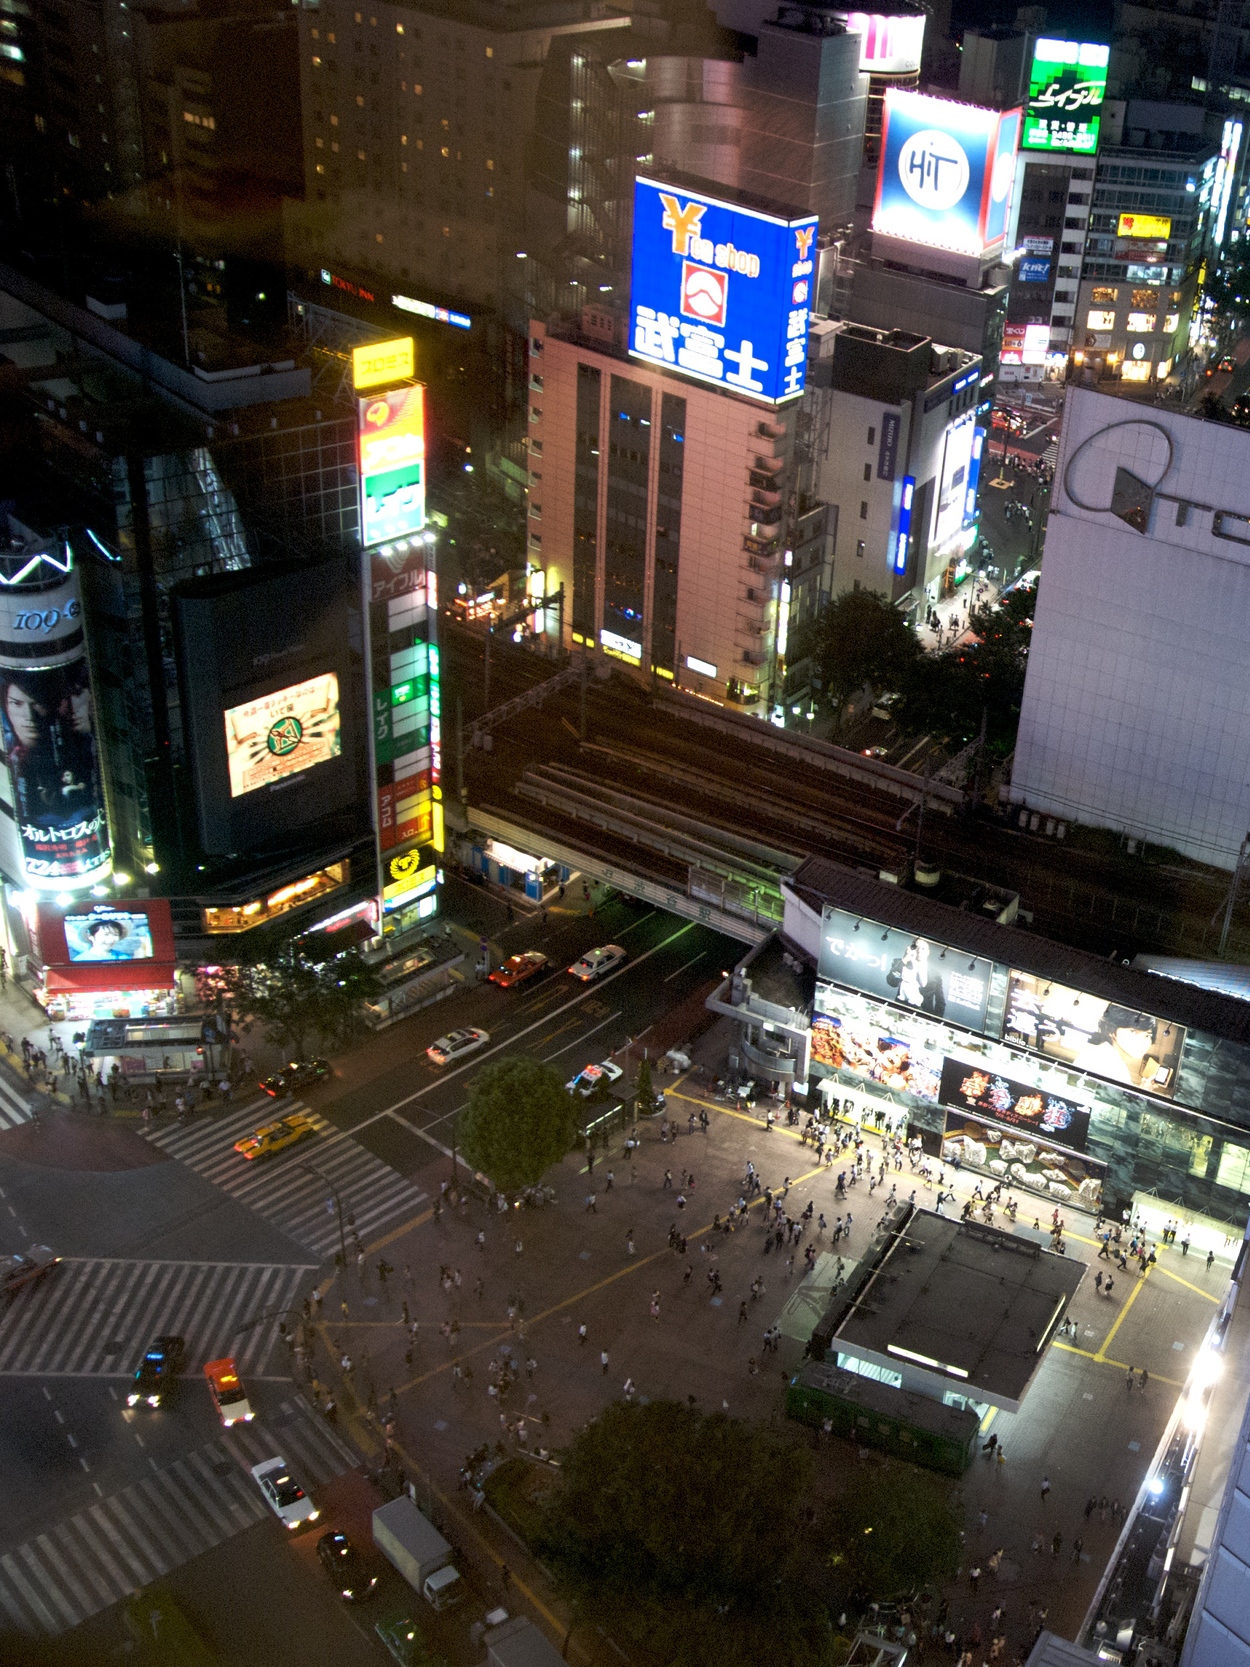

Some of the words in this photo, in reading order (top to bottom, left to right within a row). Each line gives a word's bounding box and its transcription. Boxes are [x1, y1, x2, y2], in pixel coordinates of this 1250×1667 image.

[635, 305, 768, 392] 武富士
[361, 353, 408, 374] プロミス
[373, 569, 424, 598] アイフル
[1004, 1034, 1026, 1047] biblio
